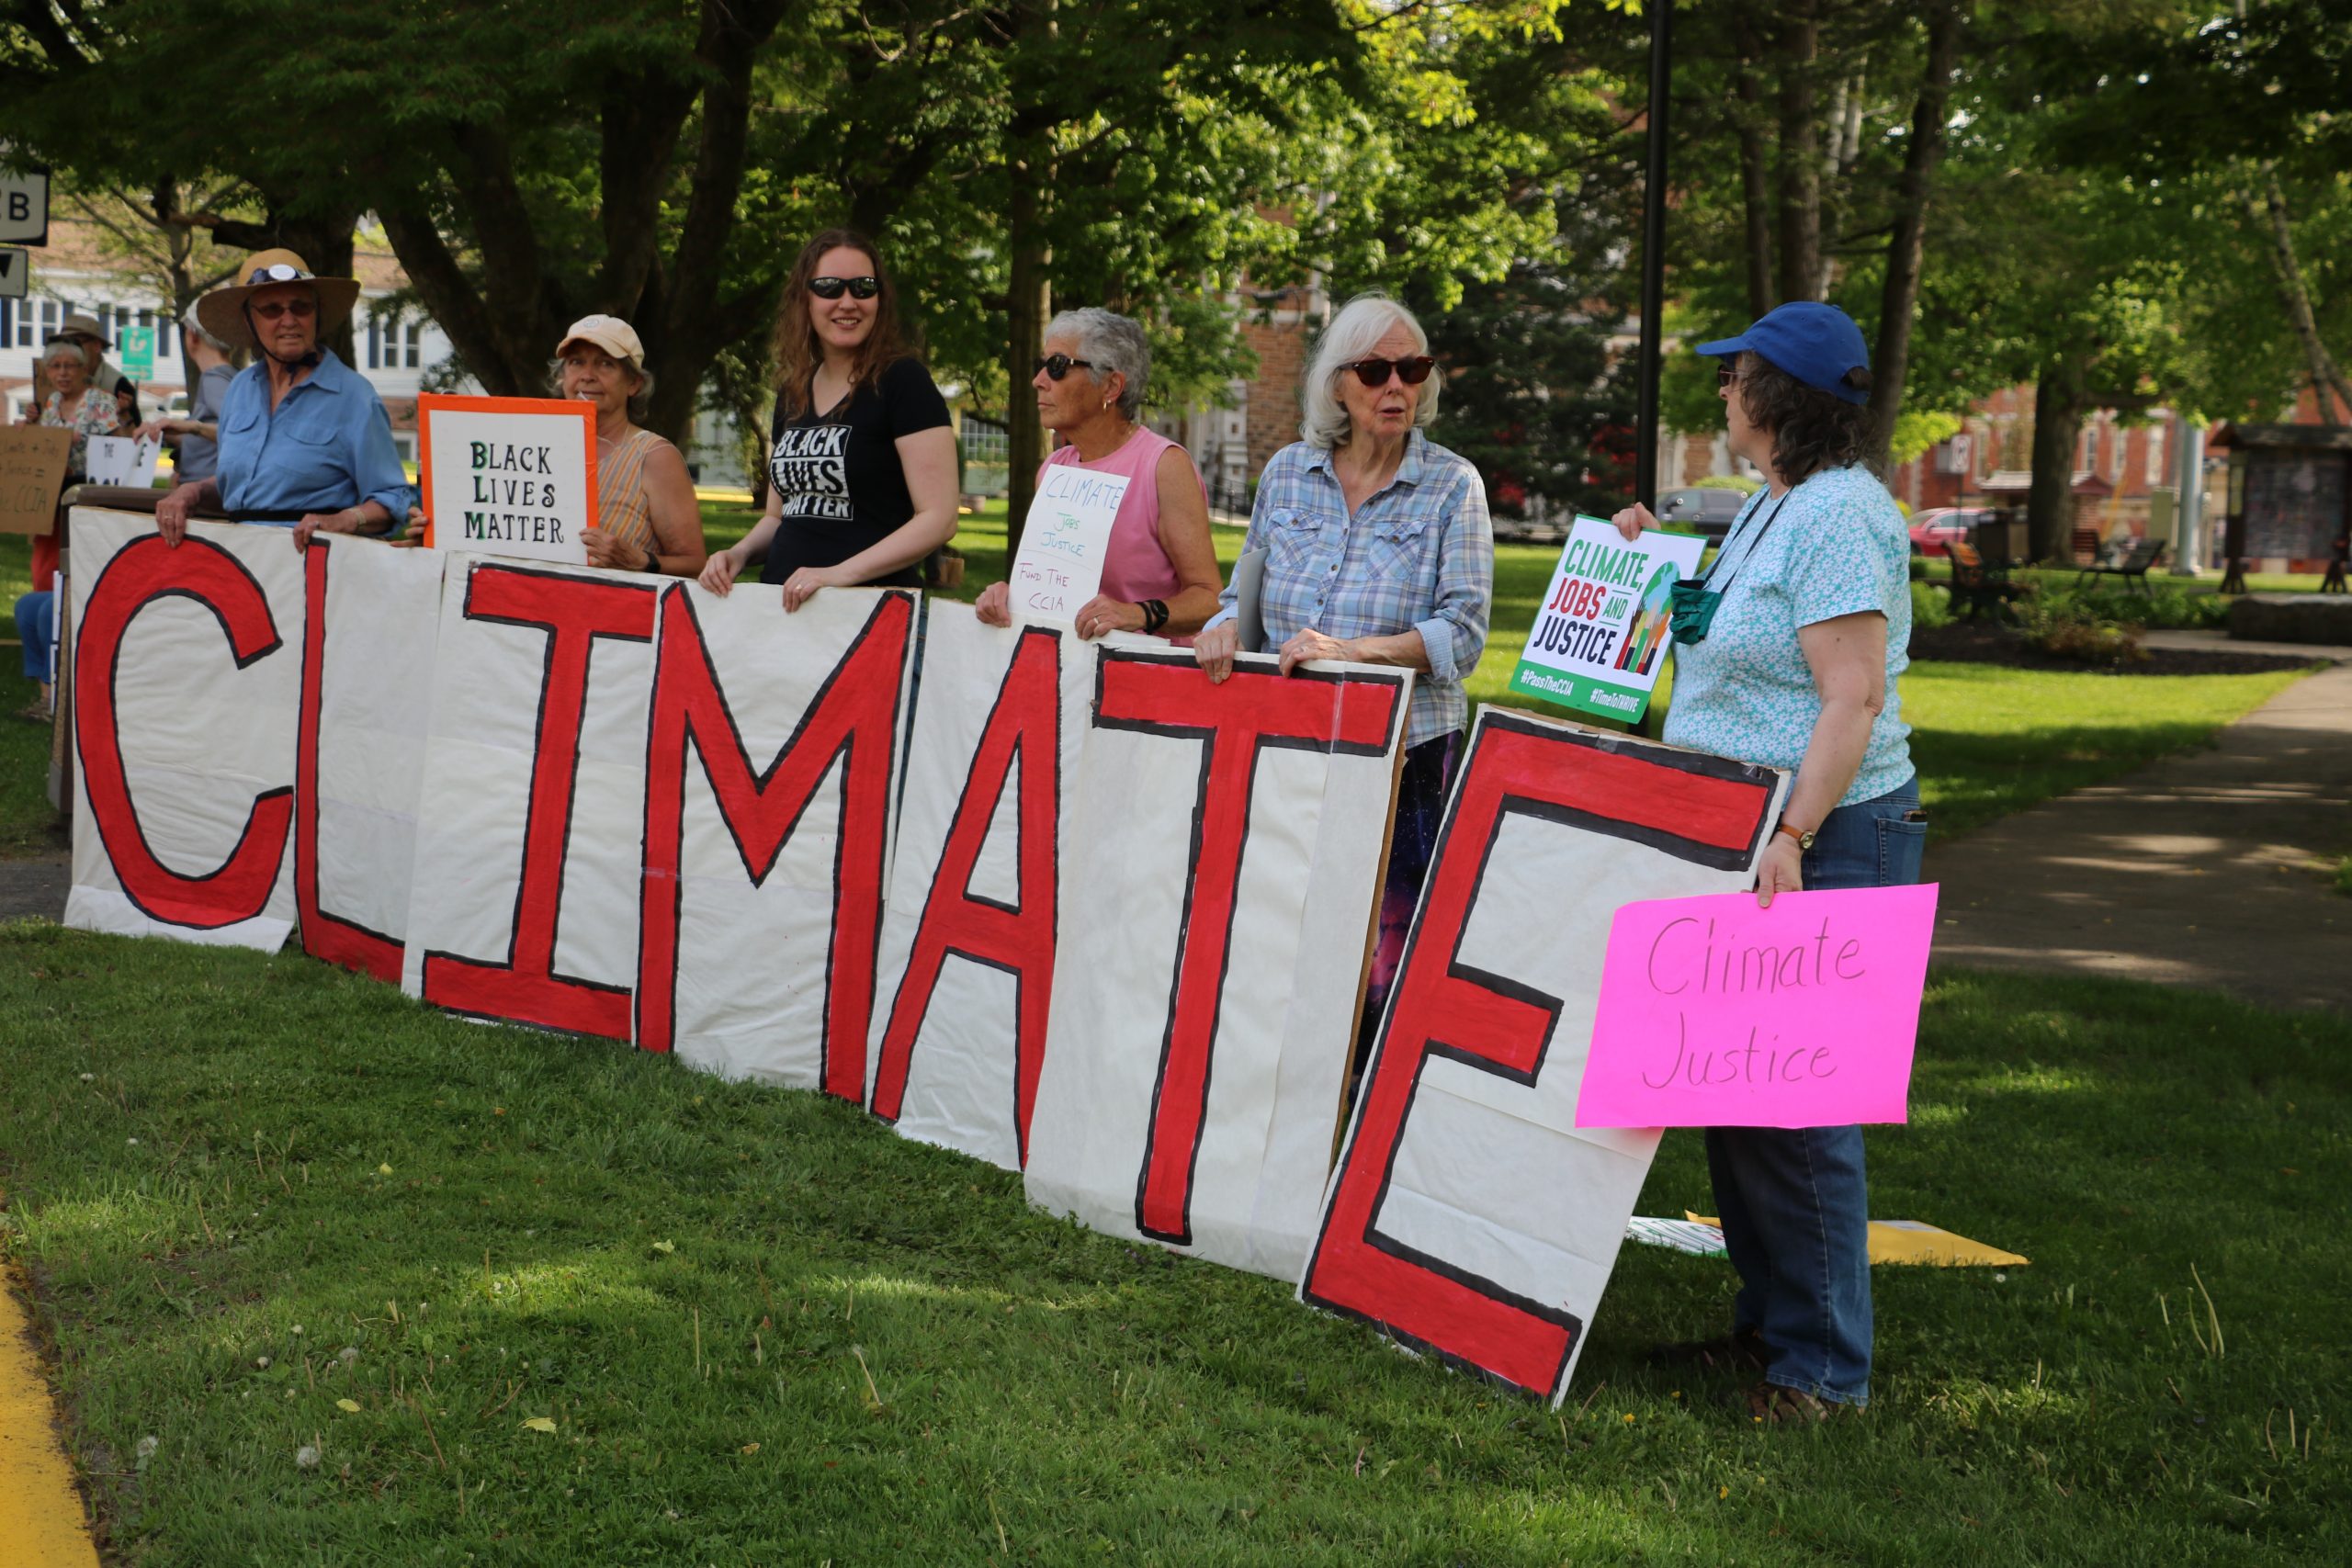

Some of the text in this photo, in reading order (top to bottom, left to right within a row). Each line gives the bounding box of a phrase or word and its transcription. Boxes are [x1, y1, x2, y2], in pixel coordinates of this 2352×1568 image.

[0, 191, 29, 220] B
[470, 441, 551, 474] BLACK
[774, 427, 846, 457] BLACK
[473, 475, 555, 508] LIVES
[771, 459, 843, 494] LIVES
[1046, 472, 1125, 510] CLIMATE
[782, 491, 849, 517] MATTER
[464, 511, 564, 544] MATTER
[1040, 531, 1086, 558] JUSTICE
[1019, 562, 1070, 587] FUND THE
[1564, 538, 1649, 592] CLIMATE,
[1028, 592, 1064, 612] CCIA
[1549, 577, 1629, 620] JOBS AND
[1533, 615, 1617, 665] JUSTICE
[1520, 668, 1640, 713] #PassTheCCIA #TimeToTHRIVE
[74, 533, 1777, 1397] CLIMATE
[1647, 916, 1866, 995] Climate
[1642, 1011, 1838, 1089] Justice
